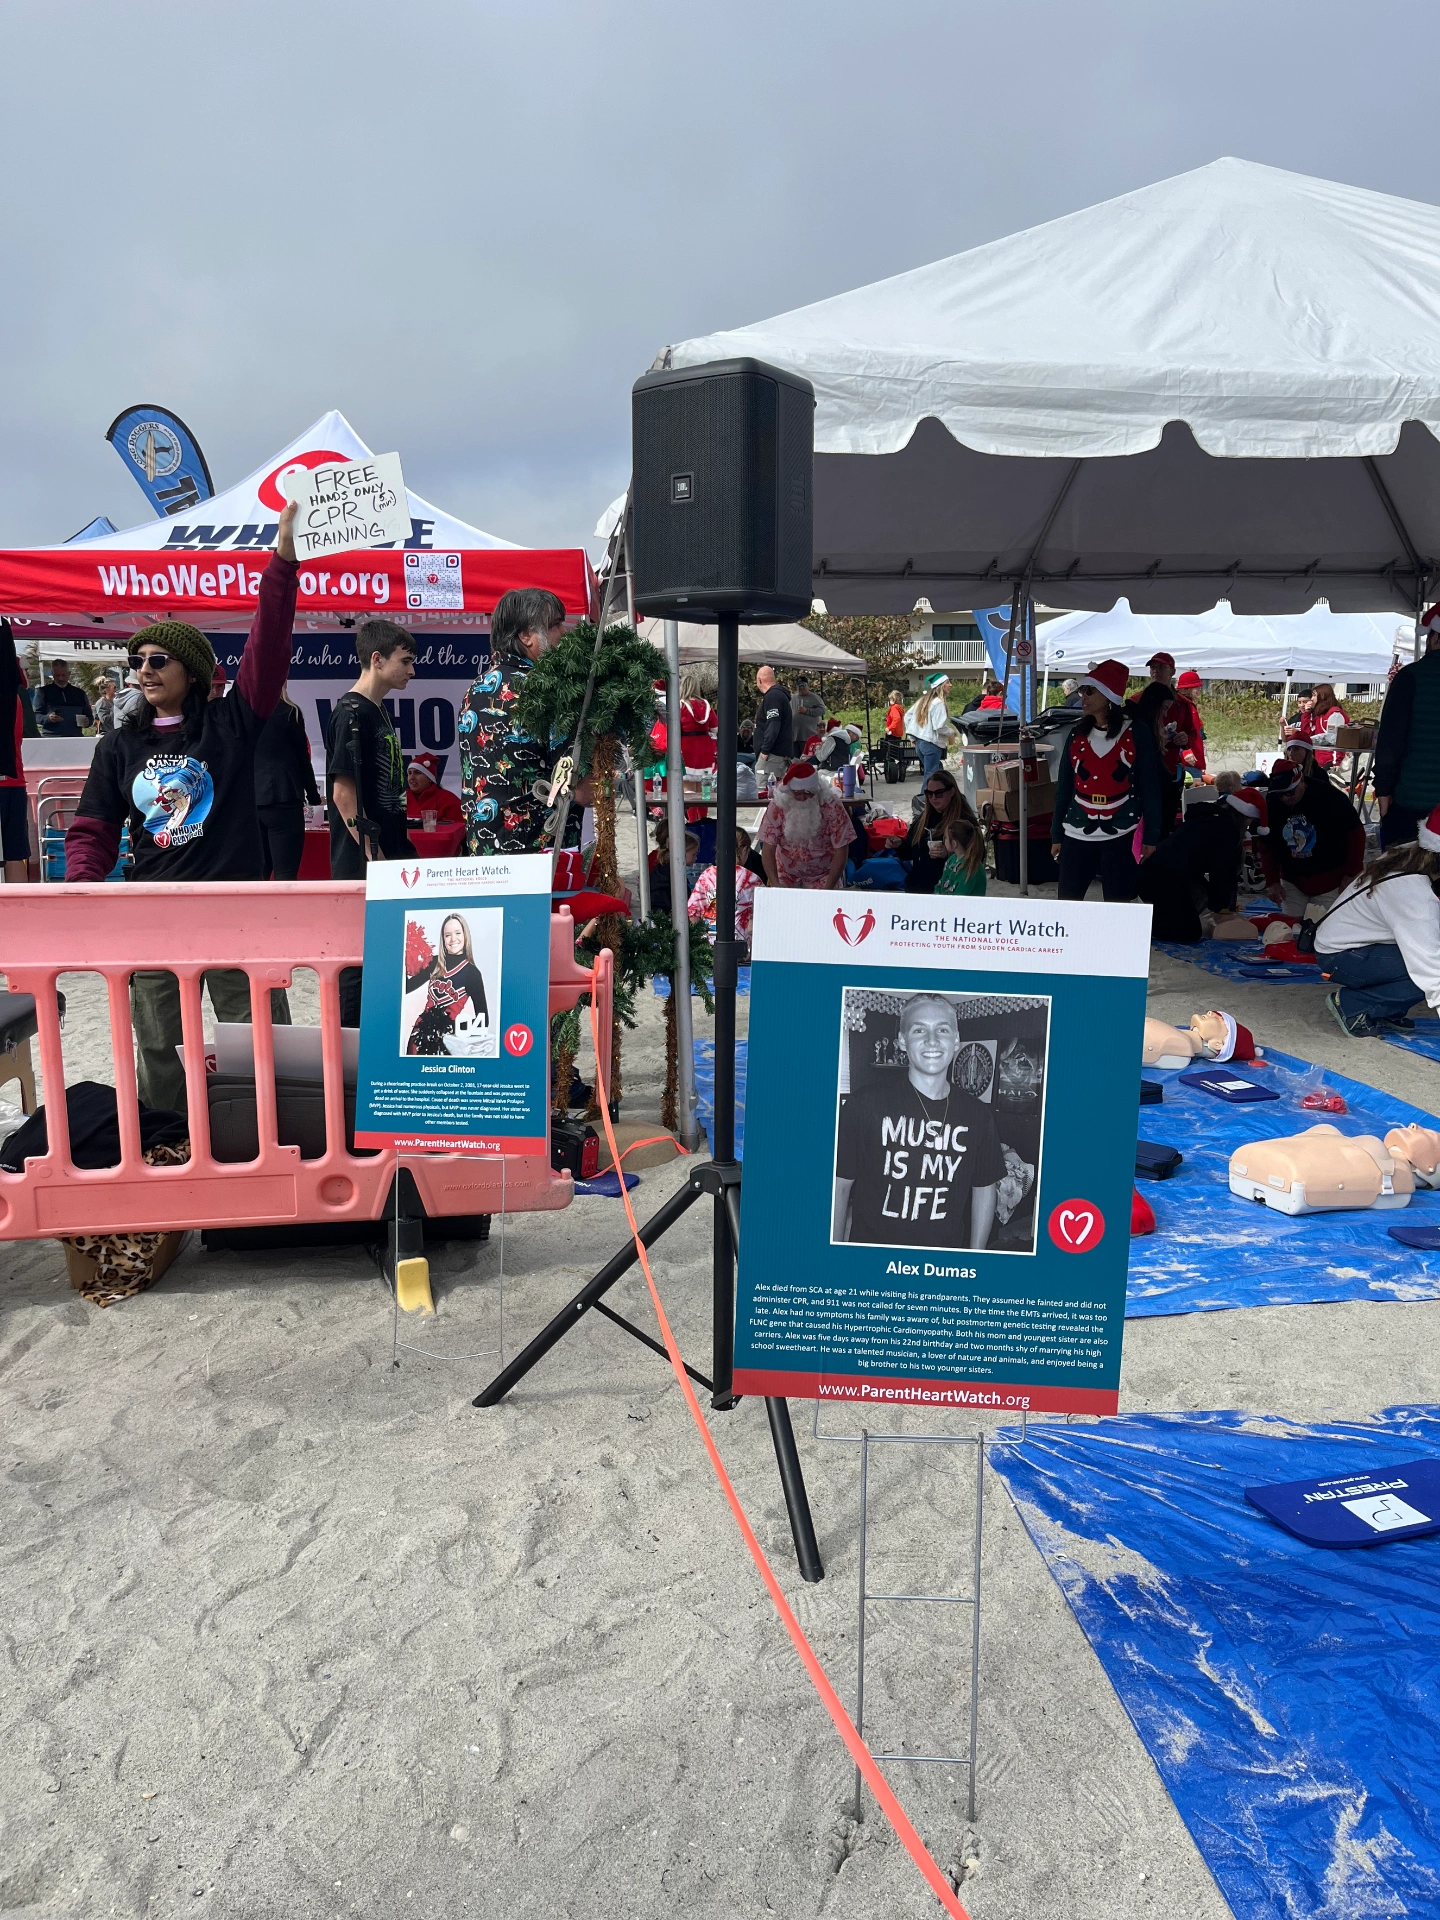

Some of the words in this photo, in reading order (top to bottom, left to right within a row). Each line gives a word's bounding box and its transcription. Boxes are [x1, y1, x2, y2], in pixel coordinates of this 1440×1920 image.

[129, 423, 160, 446] DOGGERS
[315, 465, 378, 493] FREE
[310, 491, 348, 506] HANDS
[355, 482, 384, 496] ONLY
[308, 502, 364, 529] CPR
[298, 522, 385, 551] TRAINING
[98, 563, 390, 604] WhoWePlaor.org
[308, 644, 342, 665] who
[438, 644, 467, 665] the
[316, 698, 455, 750] HO
[170, 826, 188, 836] WHO
[426, 868, 452, 878] Parent
[455, 867, 478, 876] Heart
[481, 865, 510, 875] Watch.
[890, 914, 947, 932] Parent
[953, 916, 1002, 935] Heart
[455, 1013, 488, 1037] 04
[421, 1064, 447, 1073] Jessica
[448, 1065, 475, 1074] Clinton
[999, 1089, 1038, 1097] HALO
[394, 1138, 500, 1151] www.ParentHeartWatch.org
[882, 1115, 969, 1153] MUSIC
[883, 1150, 908, 1180] IS
[921, 1154, 963, 1182] MY
[442, 1180, 531, 1191] www.oxfordplastcs.com
[882, 1184, 949, 1221] LIFE
[886, 1261, 920, 1276] Alex
[924, 1263, 976, 1279] Dumas
[789, 1284, 807, 1292] from
[880, 1290, 906, 1299] visiting
[919, 1293, 970, 1302] grandparents.
[972, 1295, 990, 1304] They
[1026, 1297, 1035, 1305] he
[1037, 1298, 1062, 1306] fainted
[752, 1295, 791, 1303] administer
[792, 1297, 809, 1305] CPR,
[826, 1298, 839, 1306] 911
[963, 1306, 972, 1315] By
[1020, 1309, 1040, 1317] EMTs
[1041, 1311, 1069, 1320] arrived,
[844, 1323, 891, 1333] Hypertrophic
[892, 1326, 953, 1337] Cardiomyopathy.
[955, 1329, 973, 1337] Both
[867, 1312, 889, 1322] family
[930, 1316, 940, 1324] of,
[942, 1316, 954, 1324] but
[1031, 1322, 1056, 1331] testing
[832, 1334, 848, 1343] days
[850, 1336, 869, 1344] away
[871, 1336, 888, 1344] from
[902, 1338, 920, 1346] 22nd
[922, 1339, 953, 1349] birthday
[1015, 1344, 1028, 1353] shy
[1038, 1347, 1072, 1356] marrying
[1085, 1348, 1101, 1357] high
[857, 1359, 868, 1368] big
[870, 1359, 898, 1368] brother
[937, 1365, 967, 1373] younger
[819, 1384, 1030, 1409] www.ParentHeartWatch.org
[1303, 1478, 1409, 1504] PRESTAN
